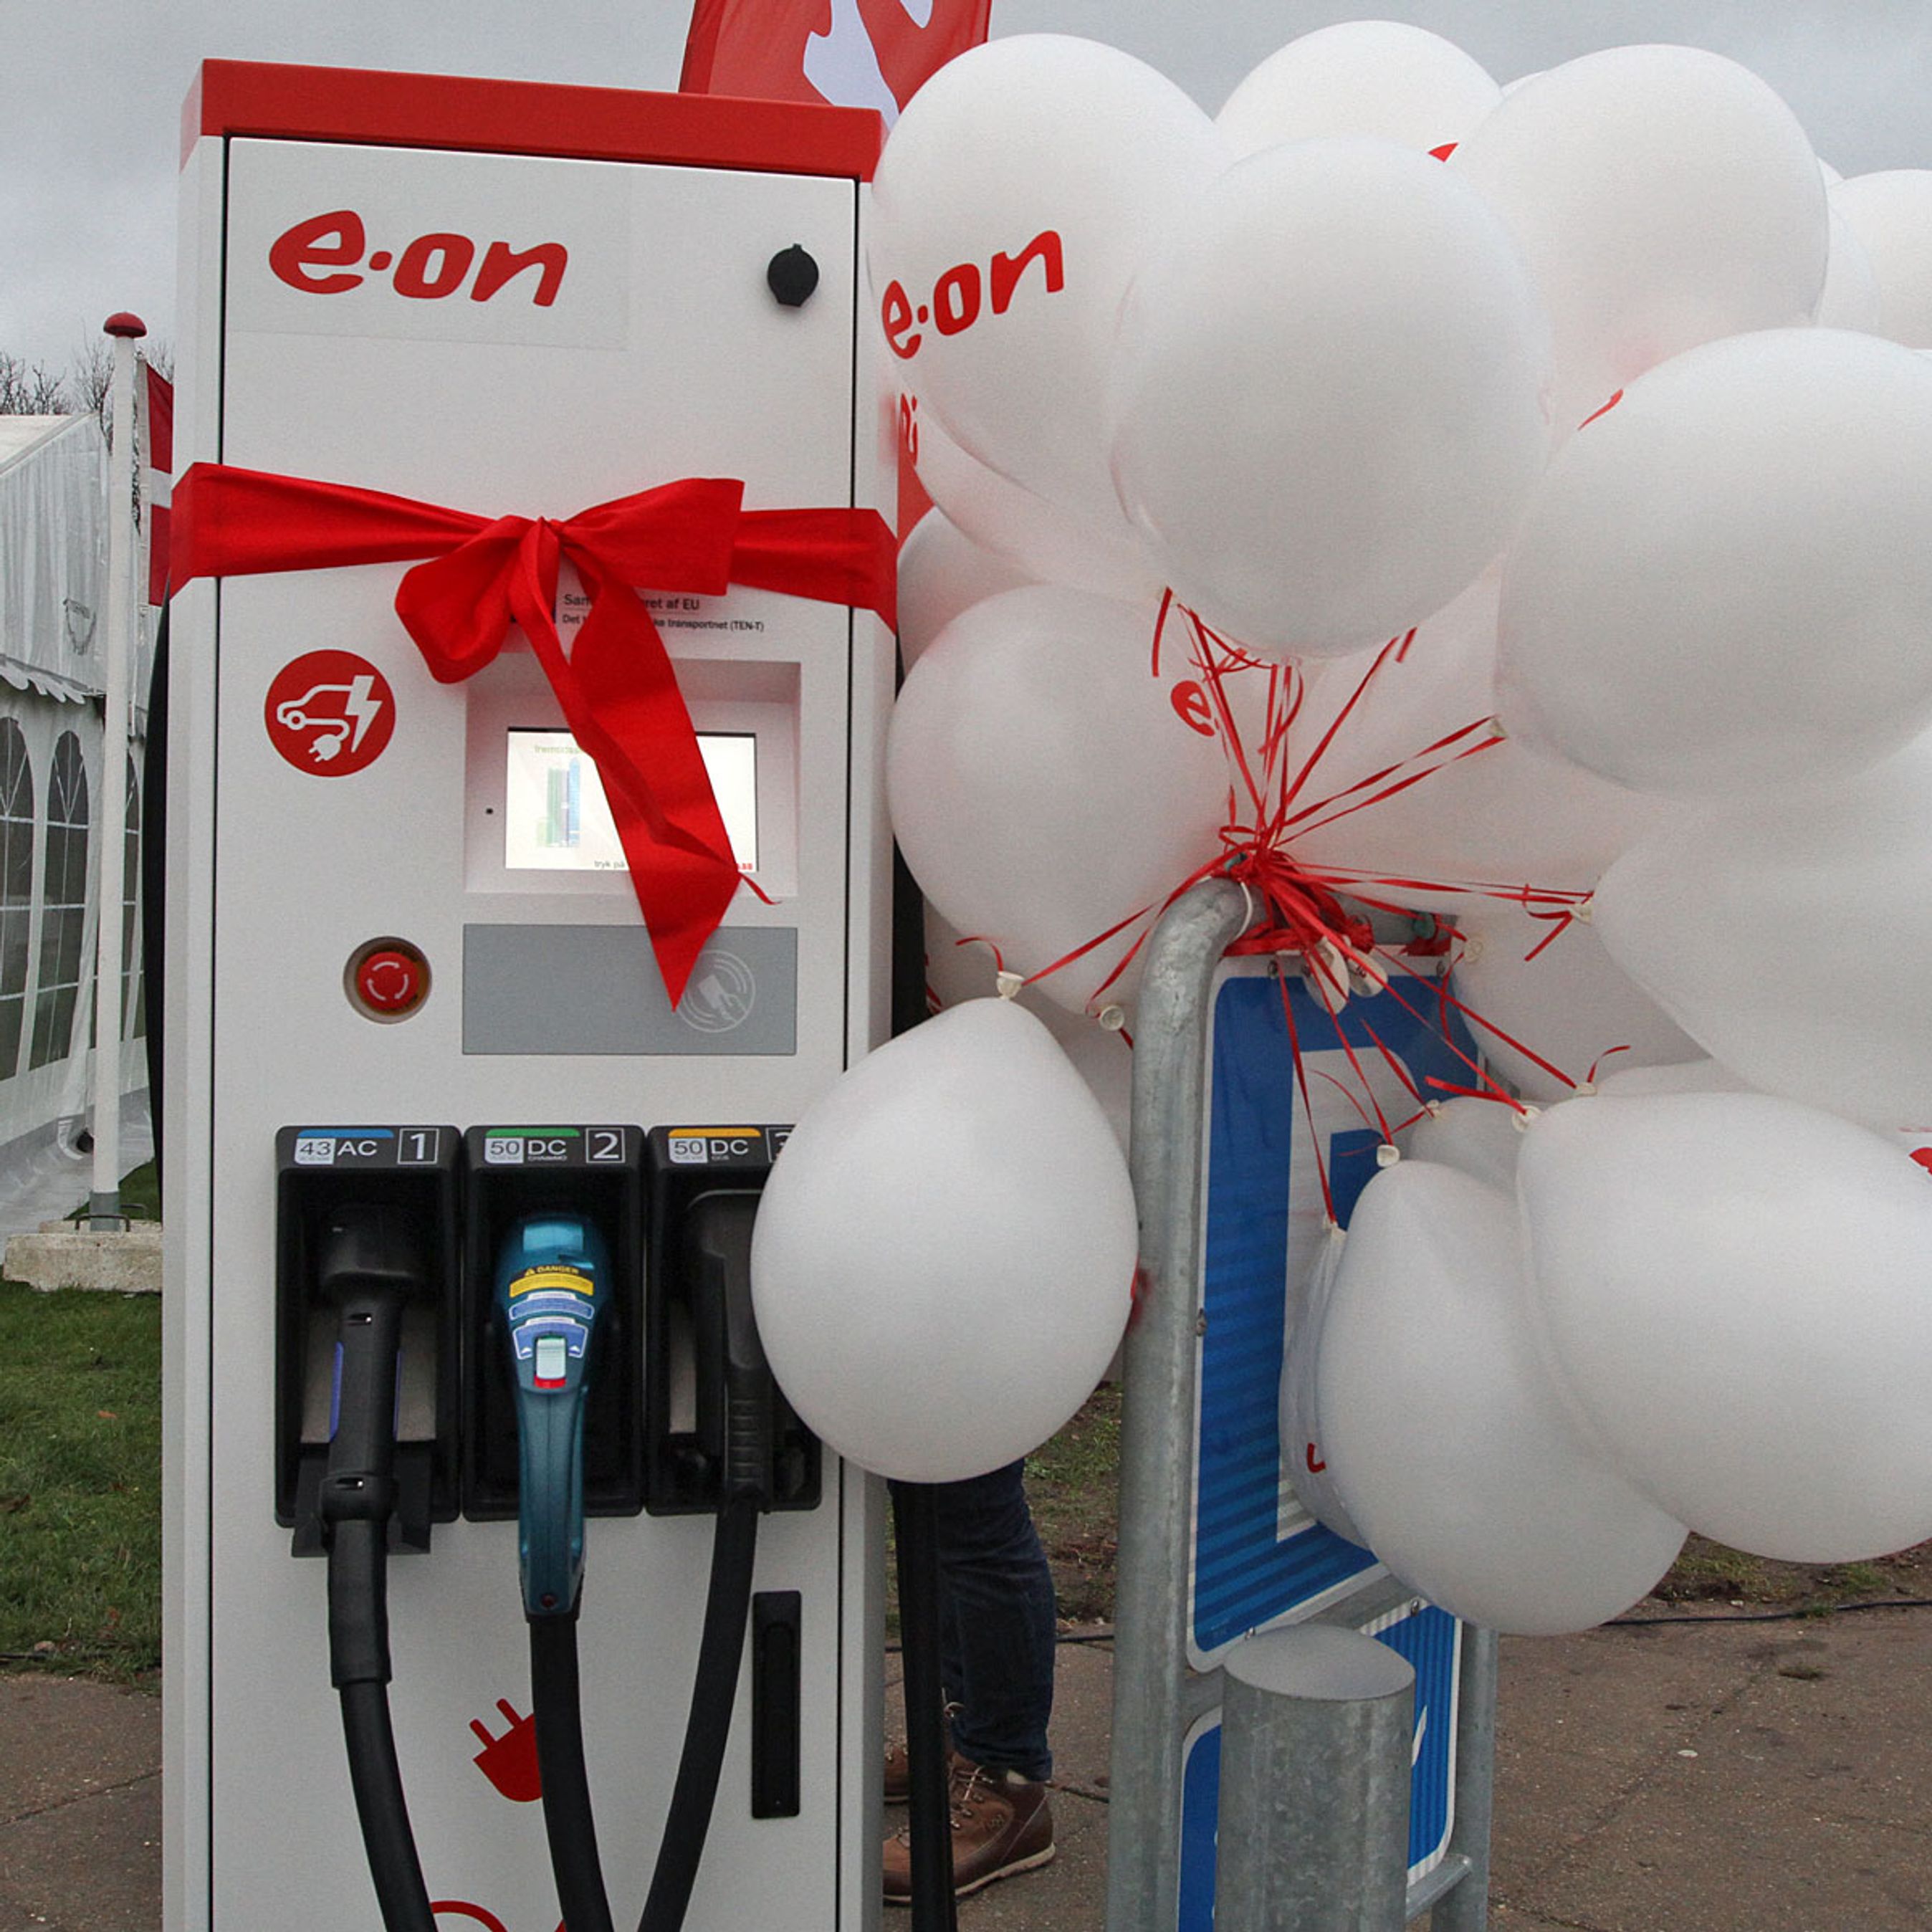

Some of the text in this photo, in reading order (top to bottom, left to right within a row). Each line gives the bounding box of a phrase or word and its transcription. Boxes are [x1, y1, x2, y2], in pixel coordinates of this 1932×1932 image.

[666, 598, 679, 609] af
[683, 598, 700, 610] EU
[562, 613, 581, 624] Det
[668, 618, 728, 630] transportnet
[730, 620, 765, 633] (TEN-T)
[300, 1132, 426, 1160] 43 AC 1
[490, 1132, 620, 1159] 50 DC 2
[674, 1139, 749, 1155] 50 DC
[537, 1265, 580, 1275] DANGER
